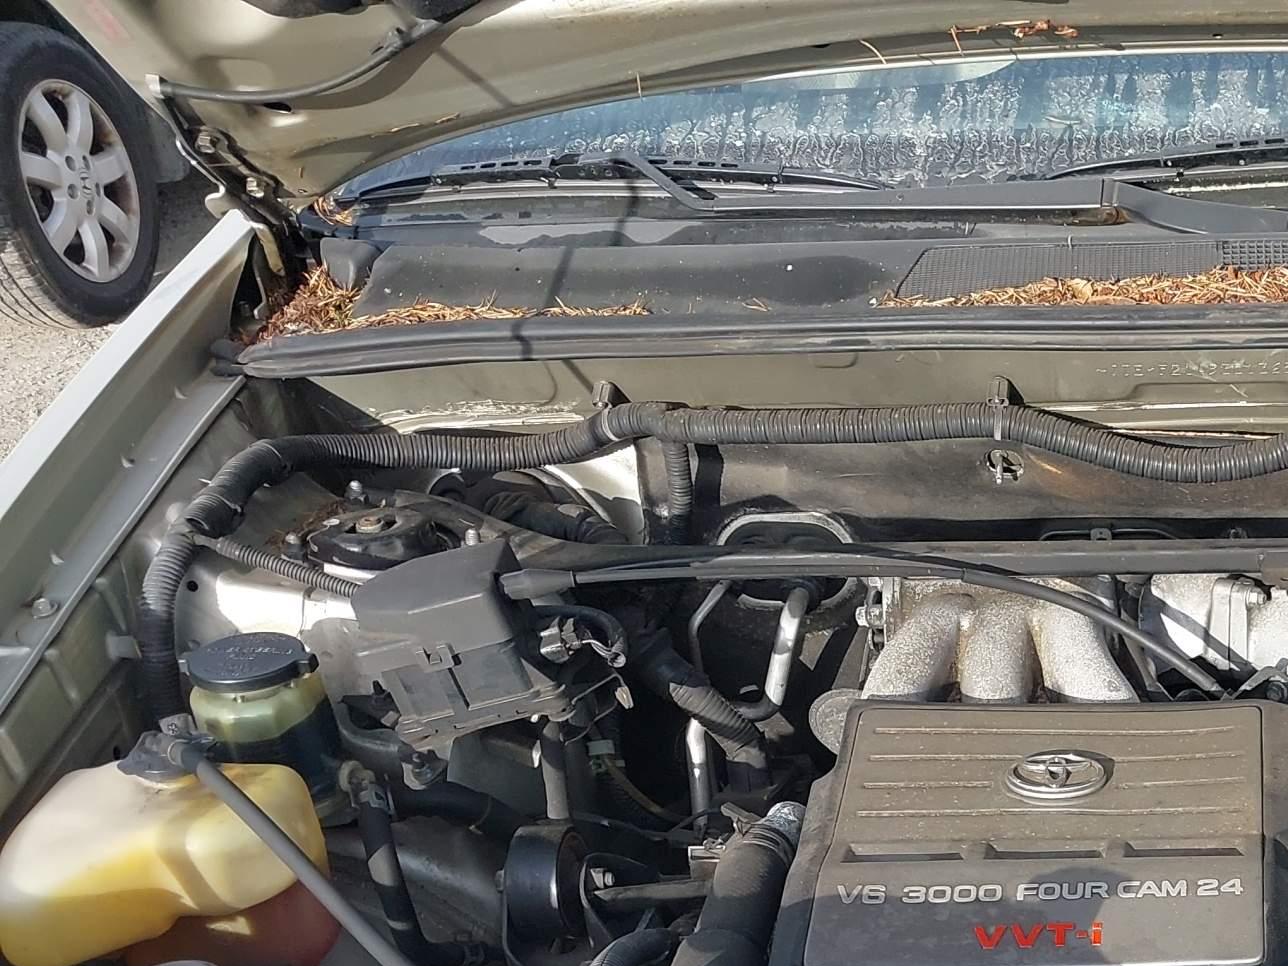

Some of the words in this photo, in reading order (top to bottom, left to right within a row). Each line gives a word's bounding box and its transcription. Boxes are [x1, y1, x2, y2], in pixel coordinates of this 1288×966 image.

[838, 884, 886, 905] V6
[902, 884, 1002, 904] 3000
[1016, 881, 1110, 901] FOUR
[1117, 879, 1187, 899] CAM
[1197, 878, 1244, 897] 24
[974, 921, 1104, 949] VVT-i
